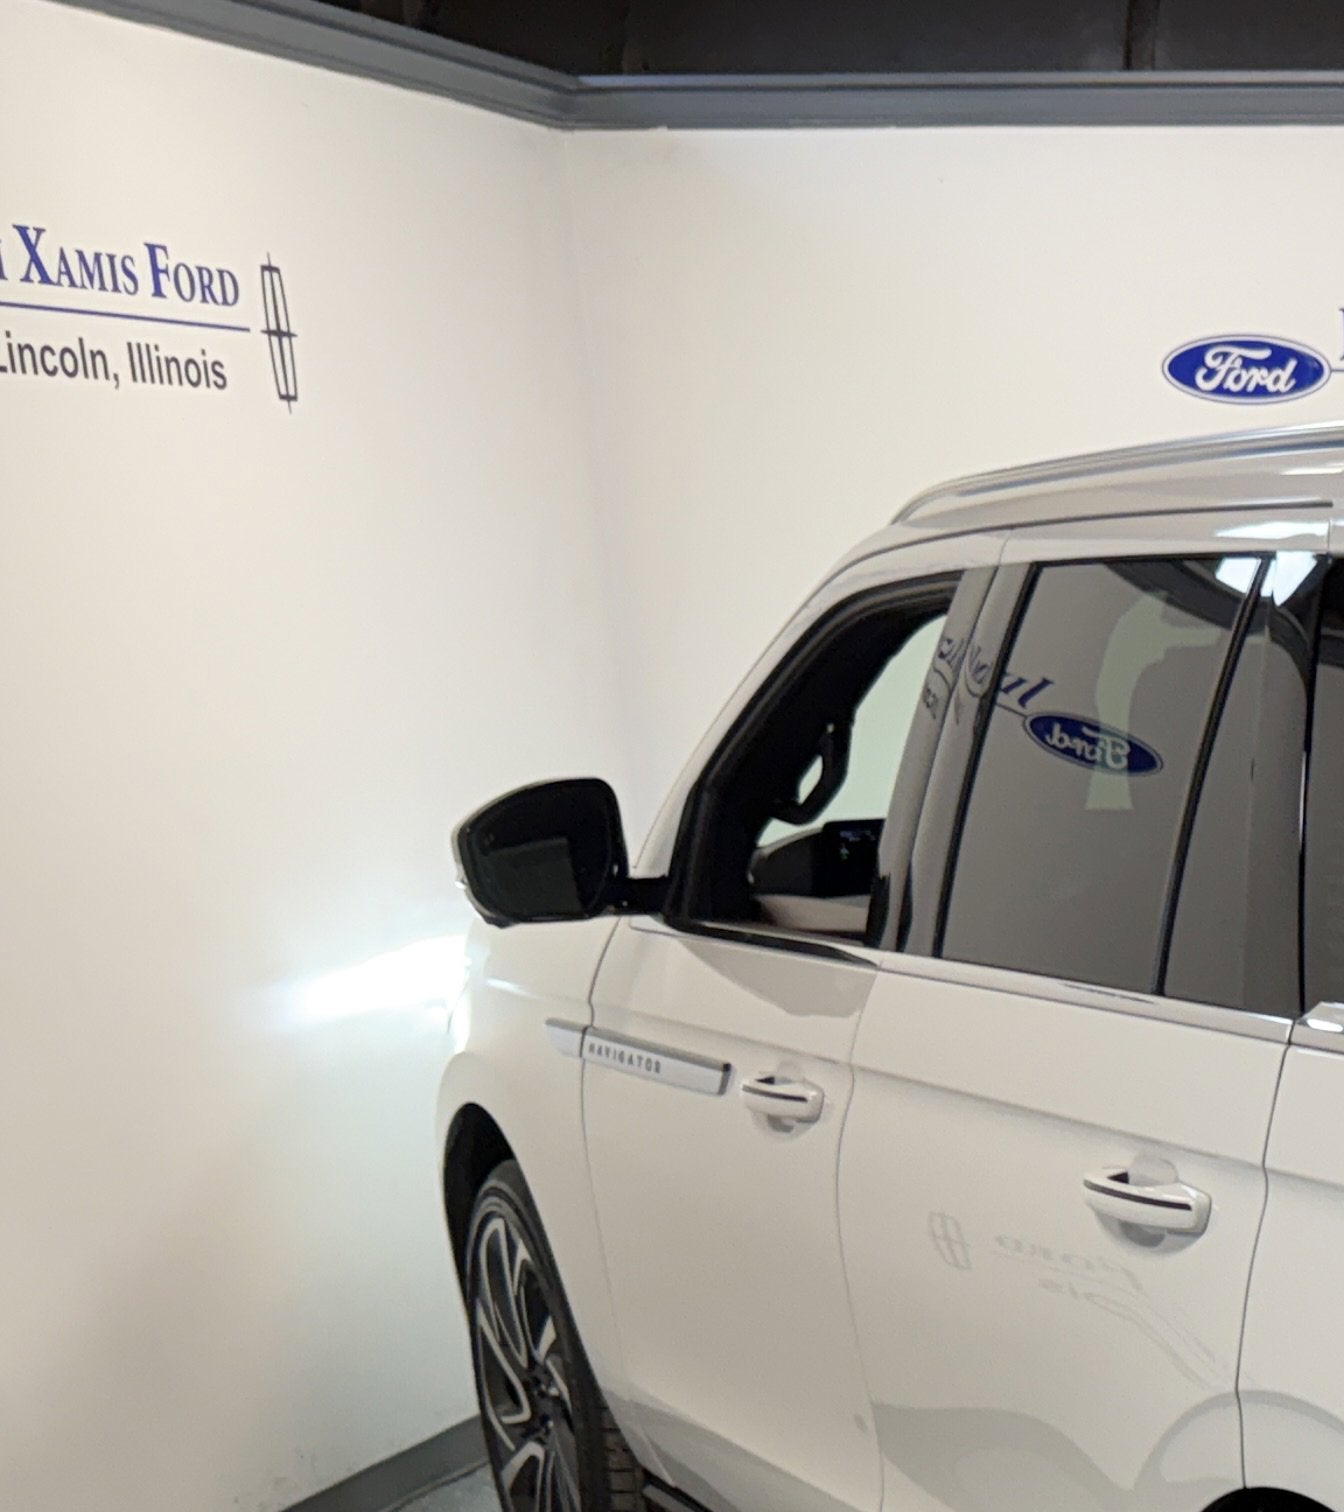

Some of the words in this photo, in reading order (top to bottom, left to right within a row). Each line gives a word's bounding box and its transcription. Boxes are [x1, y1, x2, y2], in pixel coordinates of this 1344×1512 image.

[12, 223, 140, 297] XAMIS
[143, 241, 240, 307] FORD
[126, 340, 228, 391] Illinois
[1194, 343, 1299, 394] Ford
[589, 1043, 661, 1074] NAVIGATOR
